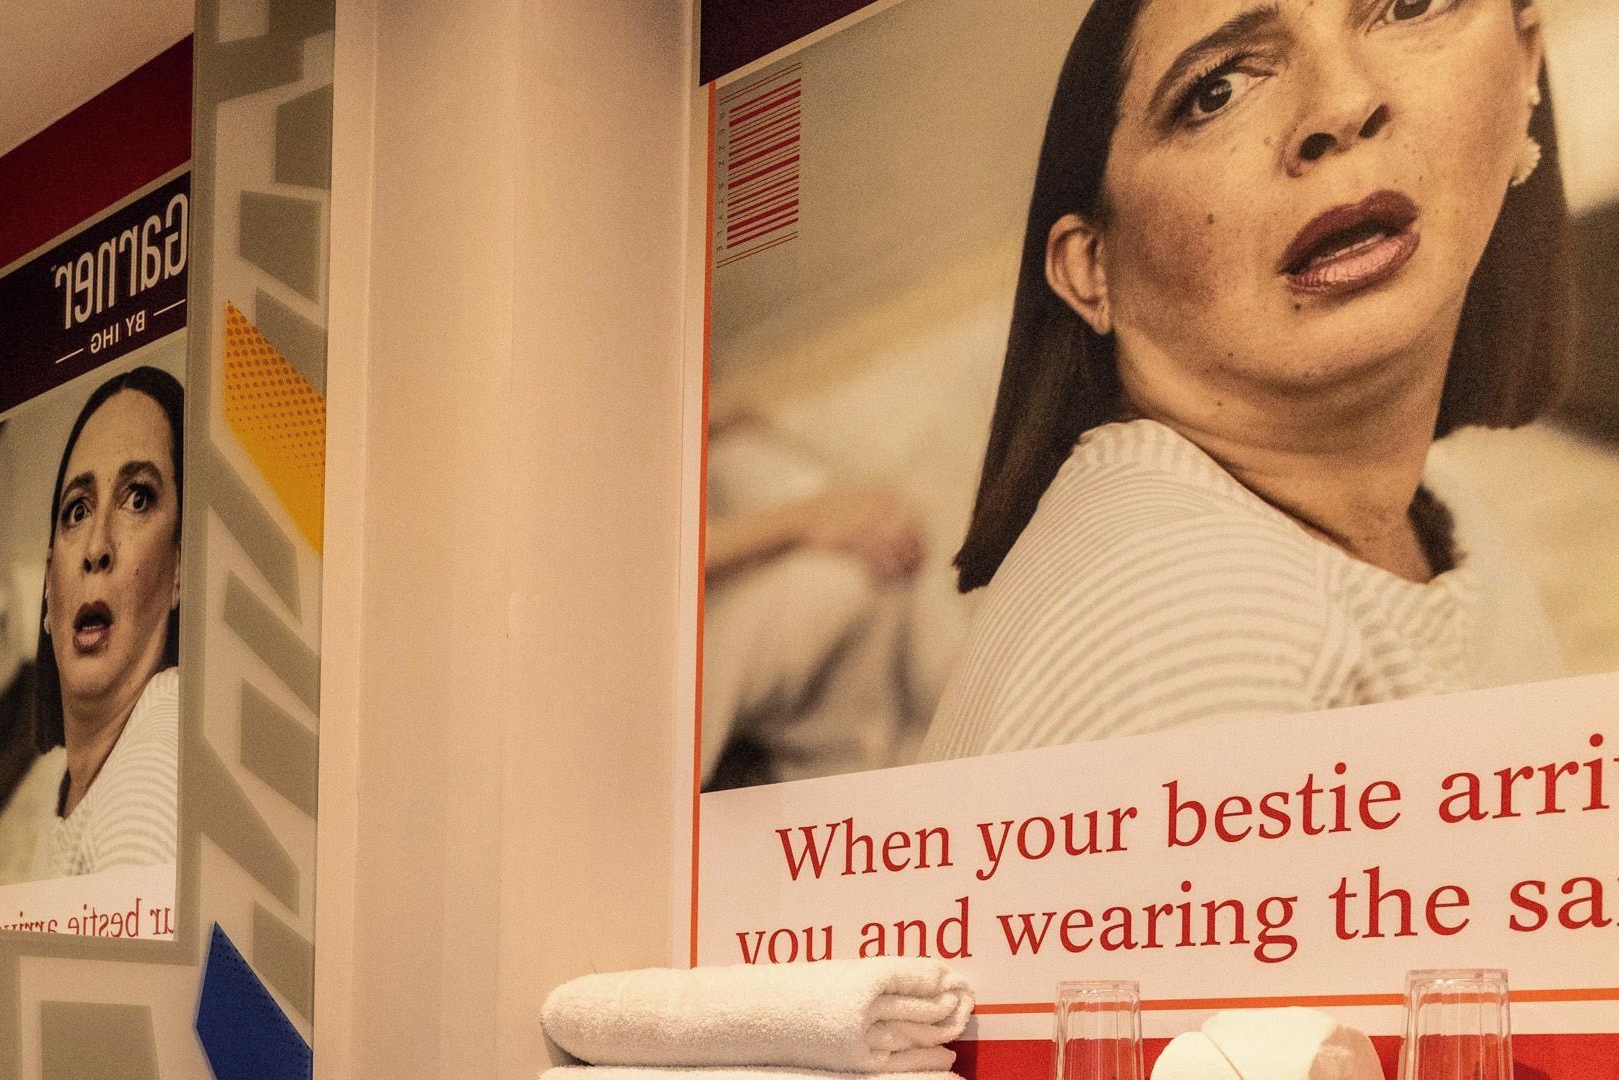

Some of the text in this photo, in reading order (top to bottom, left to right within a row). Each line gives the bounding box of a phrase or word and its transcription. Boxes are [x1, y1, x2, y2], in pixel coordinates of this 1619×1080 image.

[776, 733, 1619, 881] When your bestie arri
[858, 895, 973, 961] and
[997, 879, 1298, 965] wearing
[1329, 866, 1470, 939] the
[1509, 876, 1619, 933] sa
